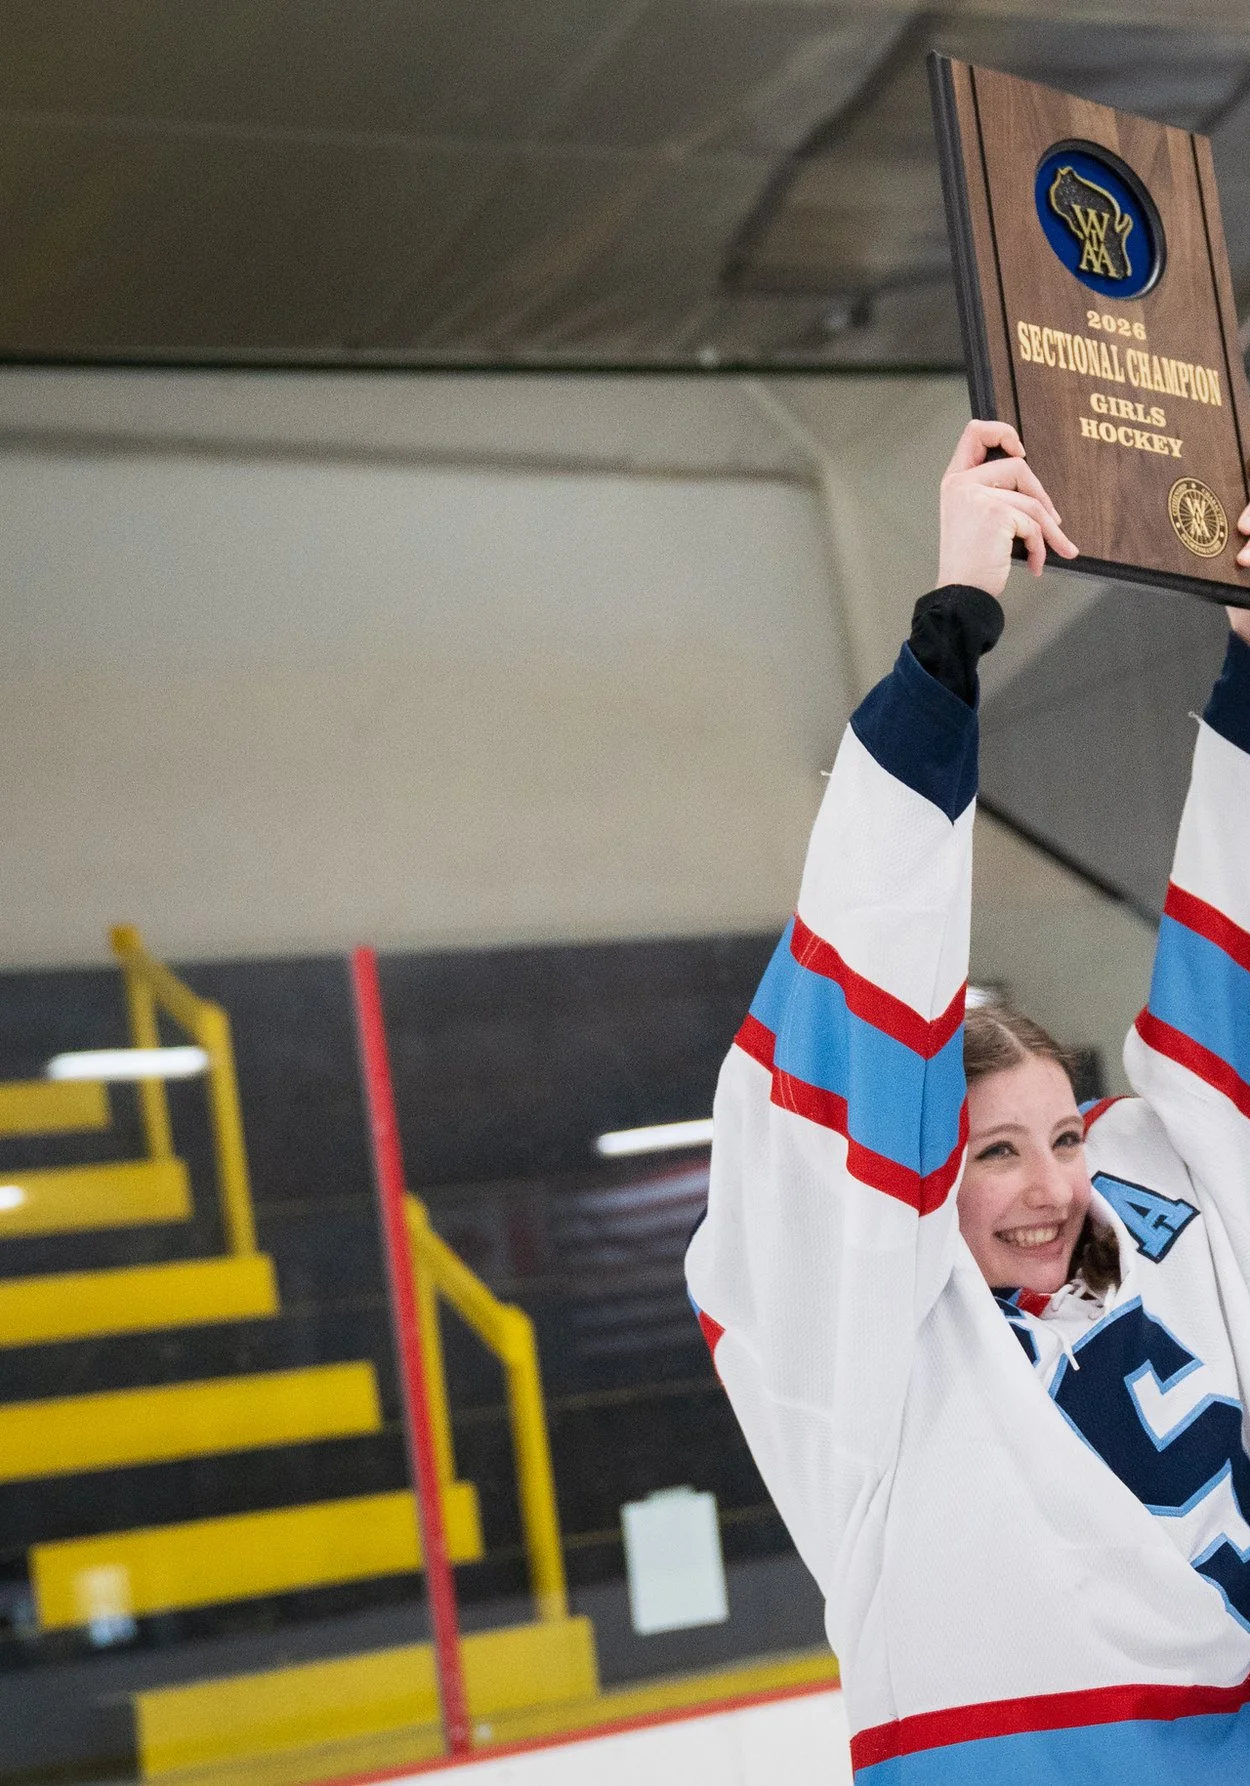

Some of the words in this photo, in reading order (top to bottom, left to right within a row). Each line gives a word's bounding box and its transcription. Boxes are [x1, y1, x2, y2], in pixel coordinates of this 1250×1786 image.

[1086, 310, 1147, 340] 2026
[1017, 320, 1125, 383] SECTIONAL
[1125, 348, 1222, 406] CHAMPION
[1090, 392, 1167, 427] GIRLS
[1079, 417, 1183, 457] HOCKEY
[1091, 1170, 1201, 1264] A
